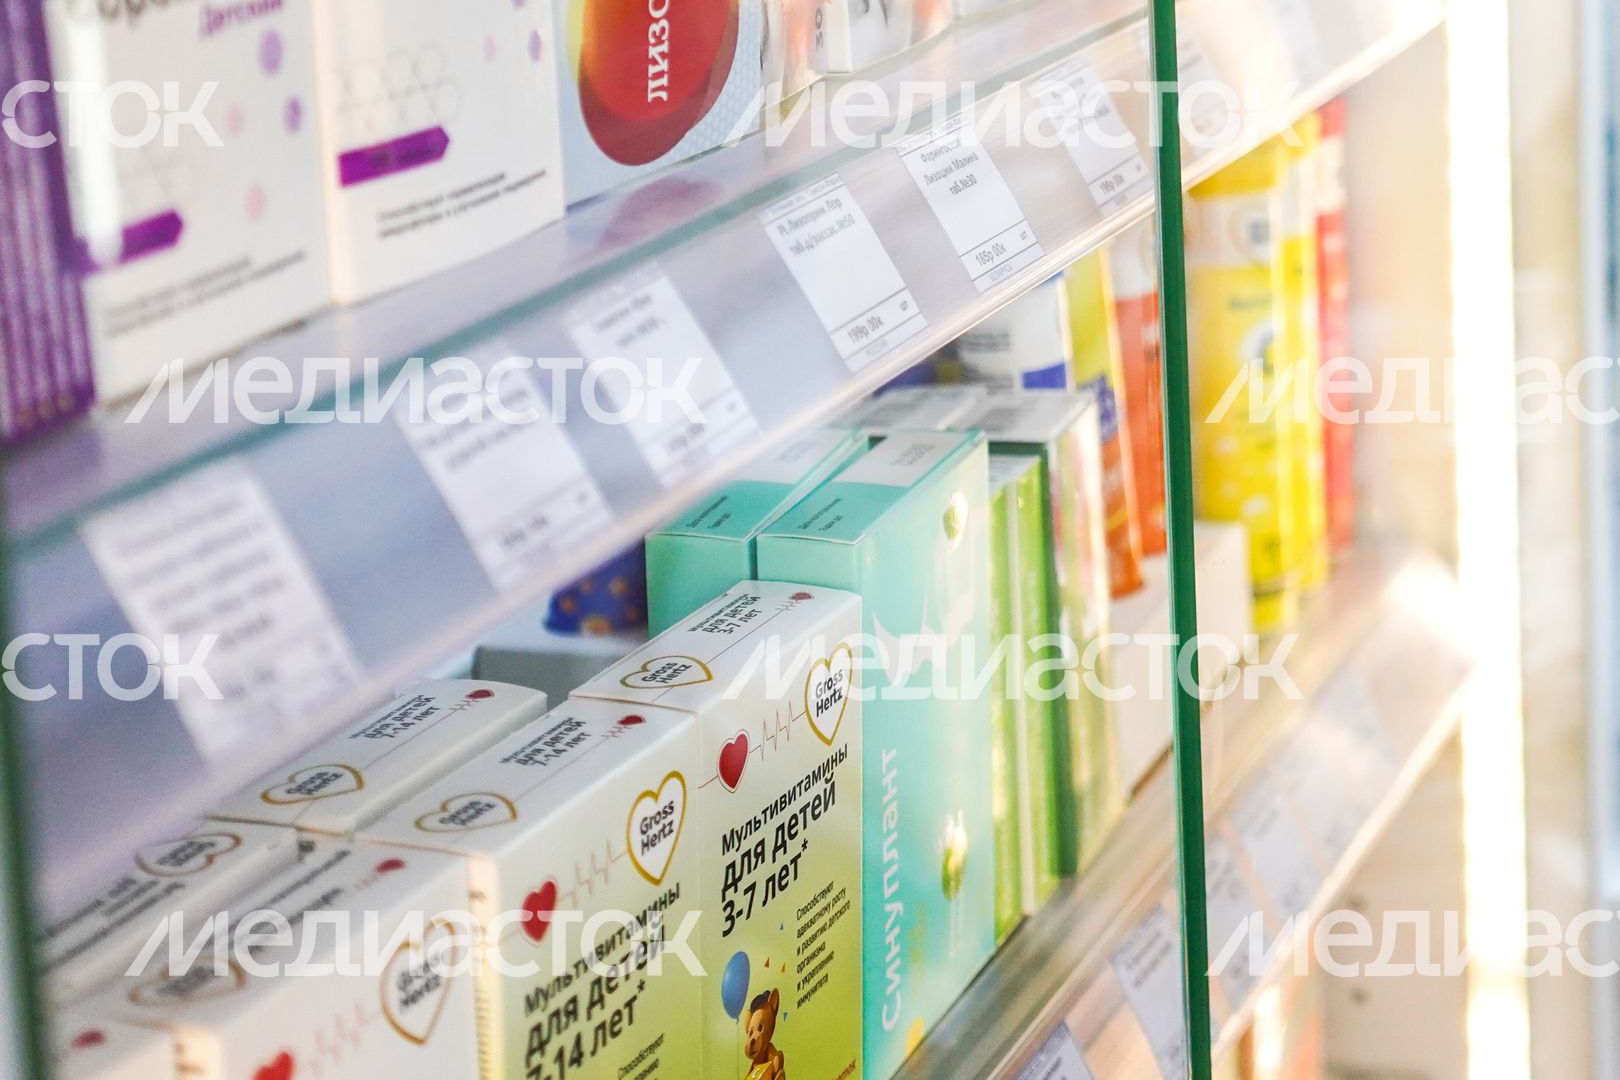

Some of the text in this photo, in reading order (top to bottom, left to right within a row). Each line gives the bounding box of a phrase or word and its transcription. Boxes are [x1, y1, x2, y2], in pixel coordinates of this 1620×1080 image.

[641, 662, 678, 682] Gross
[656, 664, 693, 684] Hertz
[815, 668, 843, 696] Gross
[815, 688, 843, 718] Hertz
[639, 800, 675, 836] Gross
[721, 743, 848, 857] Мультивитамины
[640, 819, 674, 856] Hertz
[721, 774, 836, 903] для детей
[722, 880, 757, 939] 3-7
[880, 747, 904, 1033] Синуплант
[525, 882, 680, 1017] Мультивитамины
[526, 993, 579, 1069] для
